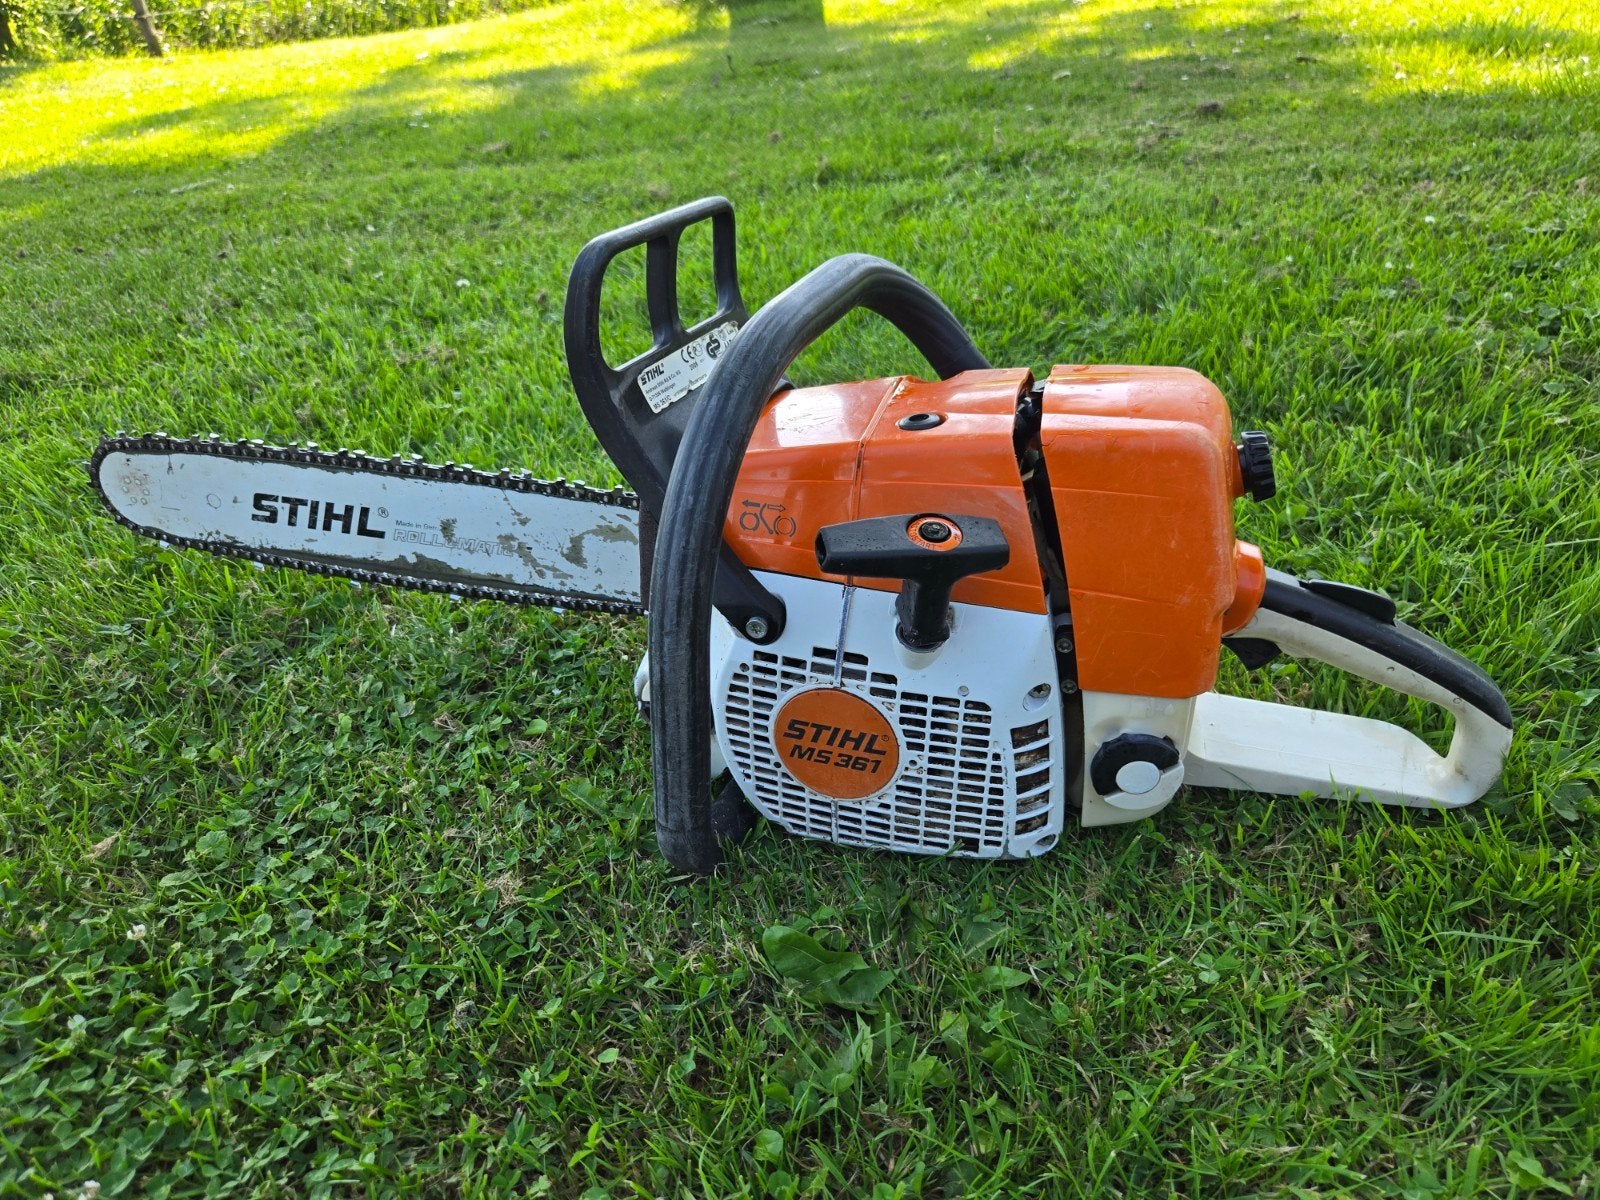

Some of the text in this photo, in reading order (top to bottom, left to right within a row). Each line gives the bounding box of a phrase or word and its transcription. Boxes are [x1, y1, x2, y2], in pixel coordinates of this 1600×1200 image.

[395, 519, 414, 528] Made
[789, 744, 883, 774] MS 361
